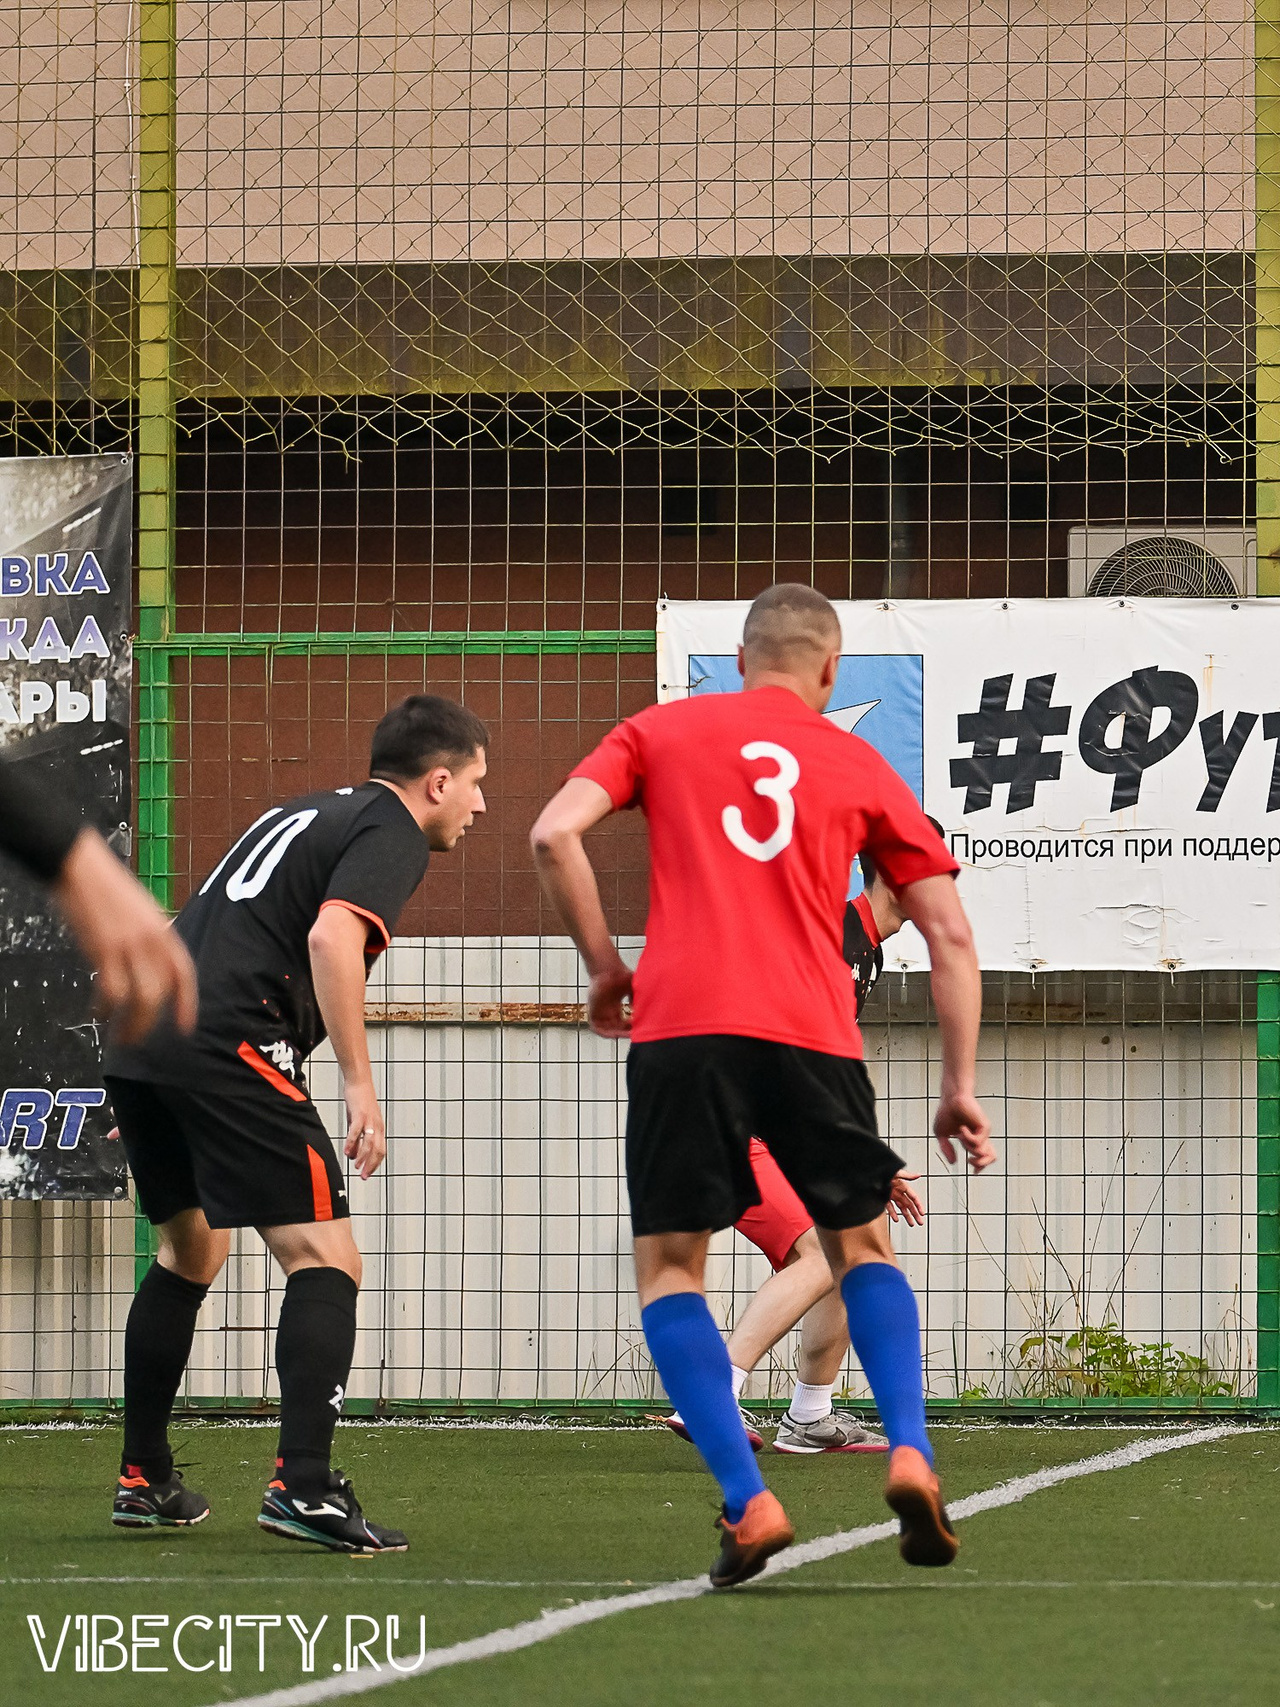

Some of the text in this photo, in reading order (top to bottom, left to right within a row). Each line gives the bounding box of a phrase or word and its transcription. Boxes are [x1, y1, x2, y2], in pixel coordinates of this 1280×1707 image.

[0, 551, 111, 597] ВКА
[721, 741, 800, 862] 3
[198, 807, 319, 903] 10
[951, 832, 1114, 864] Проводится
[1124, 840, 1173, 862] при
[0, 1088, 107, 1150] RT
